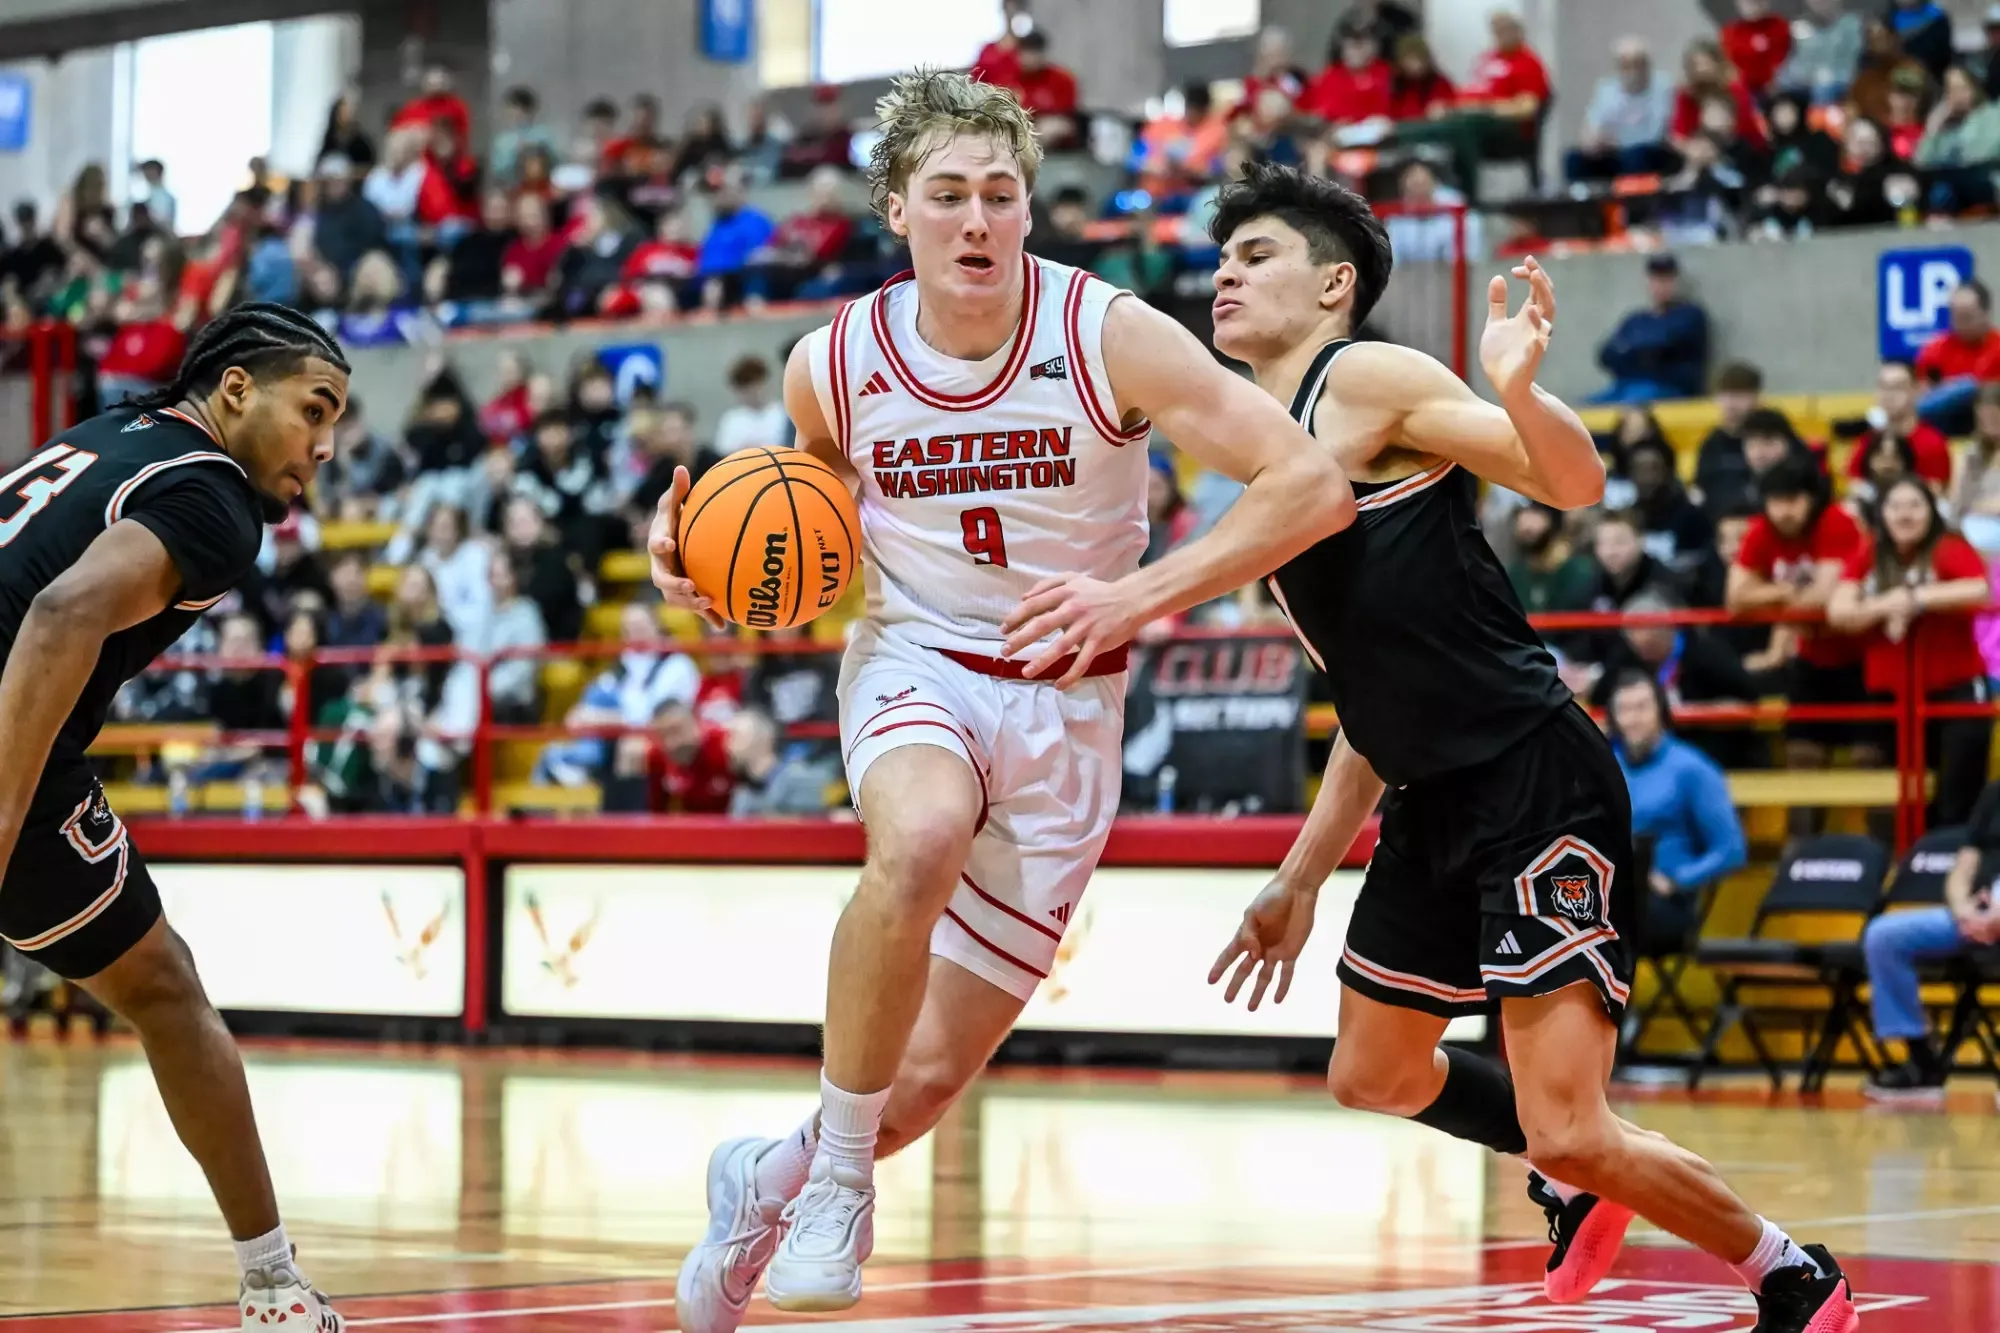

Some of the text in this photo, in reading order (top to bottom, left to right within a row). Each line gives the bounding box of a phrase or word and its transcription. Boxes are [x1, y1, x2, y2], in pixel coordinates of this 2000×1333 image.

[1045, 357, 1065, 374] SKY
[872, 426, 1072, 468] EASTERN
[874, 457, 1076, 499] WASHINGTON
[960, 506, 1008, 568] 9
[746, 532, 787, 627] Wilson
[813, 528, 840, 608] EVO NXT
